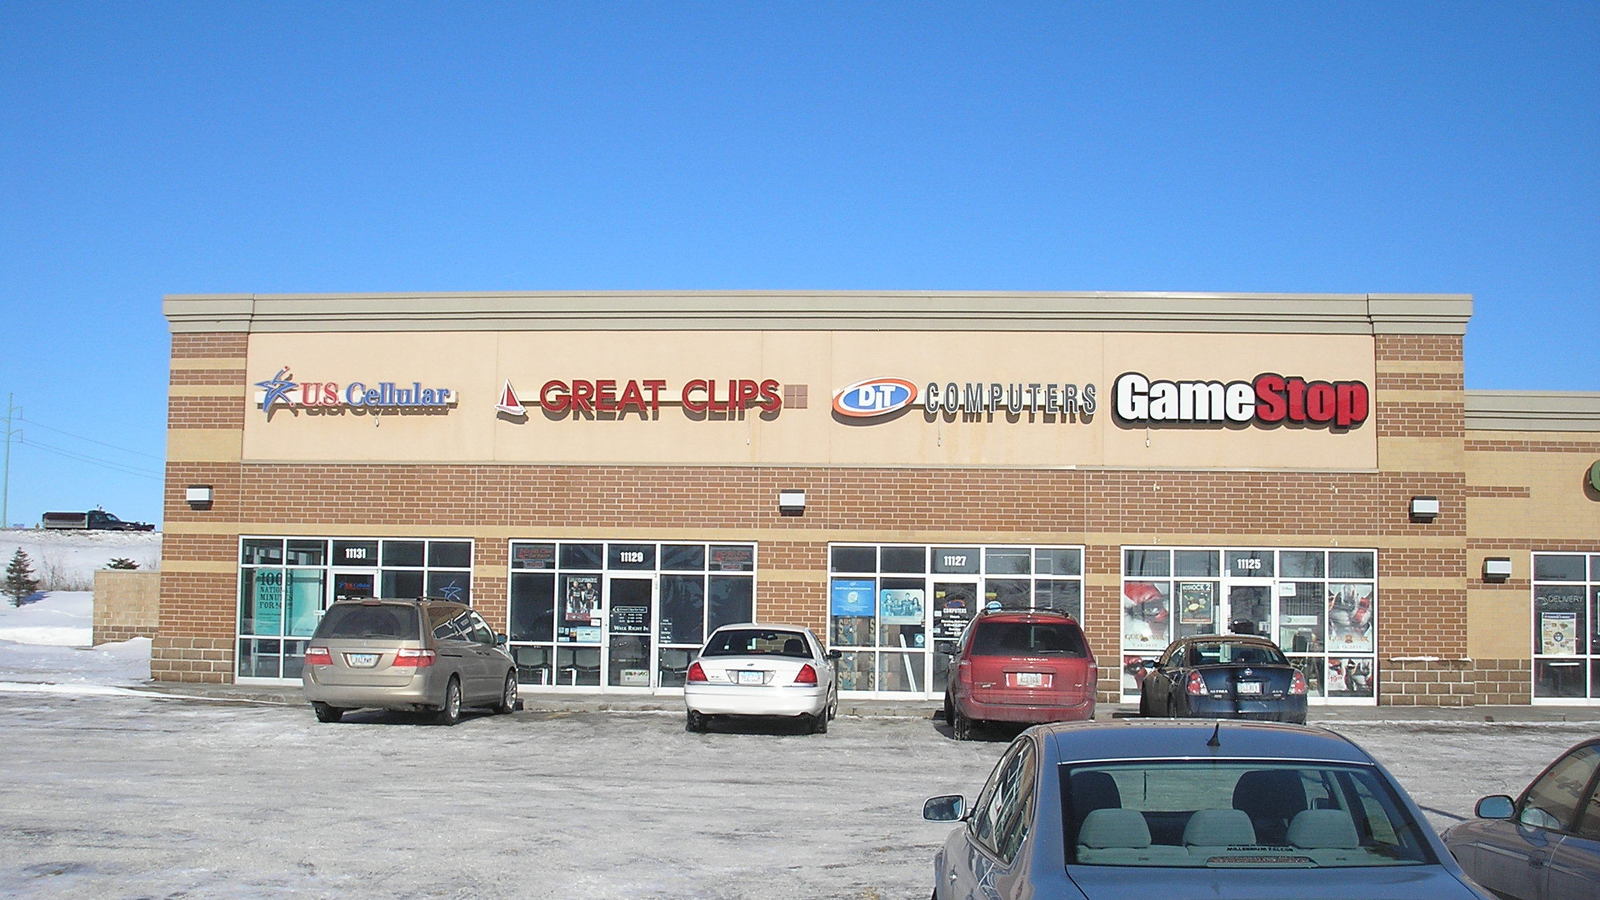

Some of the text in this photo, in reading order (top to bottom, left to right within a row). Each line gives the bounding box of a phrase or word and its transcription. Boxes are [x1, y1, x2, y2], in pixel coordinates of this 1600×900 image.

[300, 382, 450, 407] U.S. Cellular
[540, 379, 782, 412] GREAT CLIPS
[924, 382, 1097, 415] COMPUTERS
[1115, 372, 1369, 427] GameStop
[345, 548, 367, 559] 11131
[620, 551, 644, 563] 11129
[943, 555, 967, 567] 11127
[1237, 558, 1262, 570] 11125
